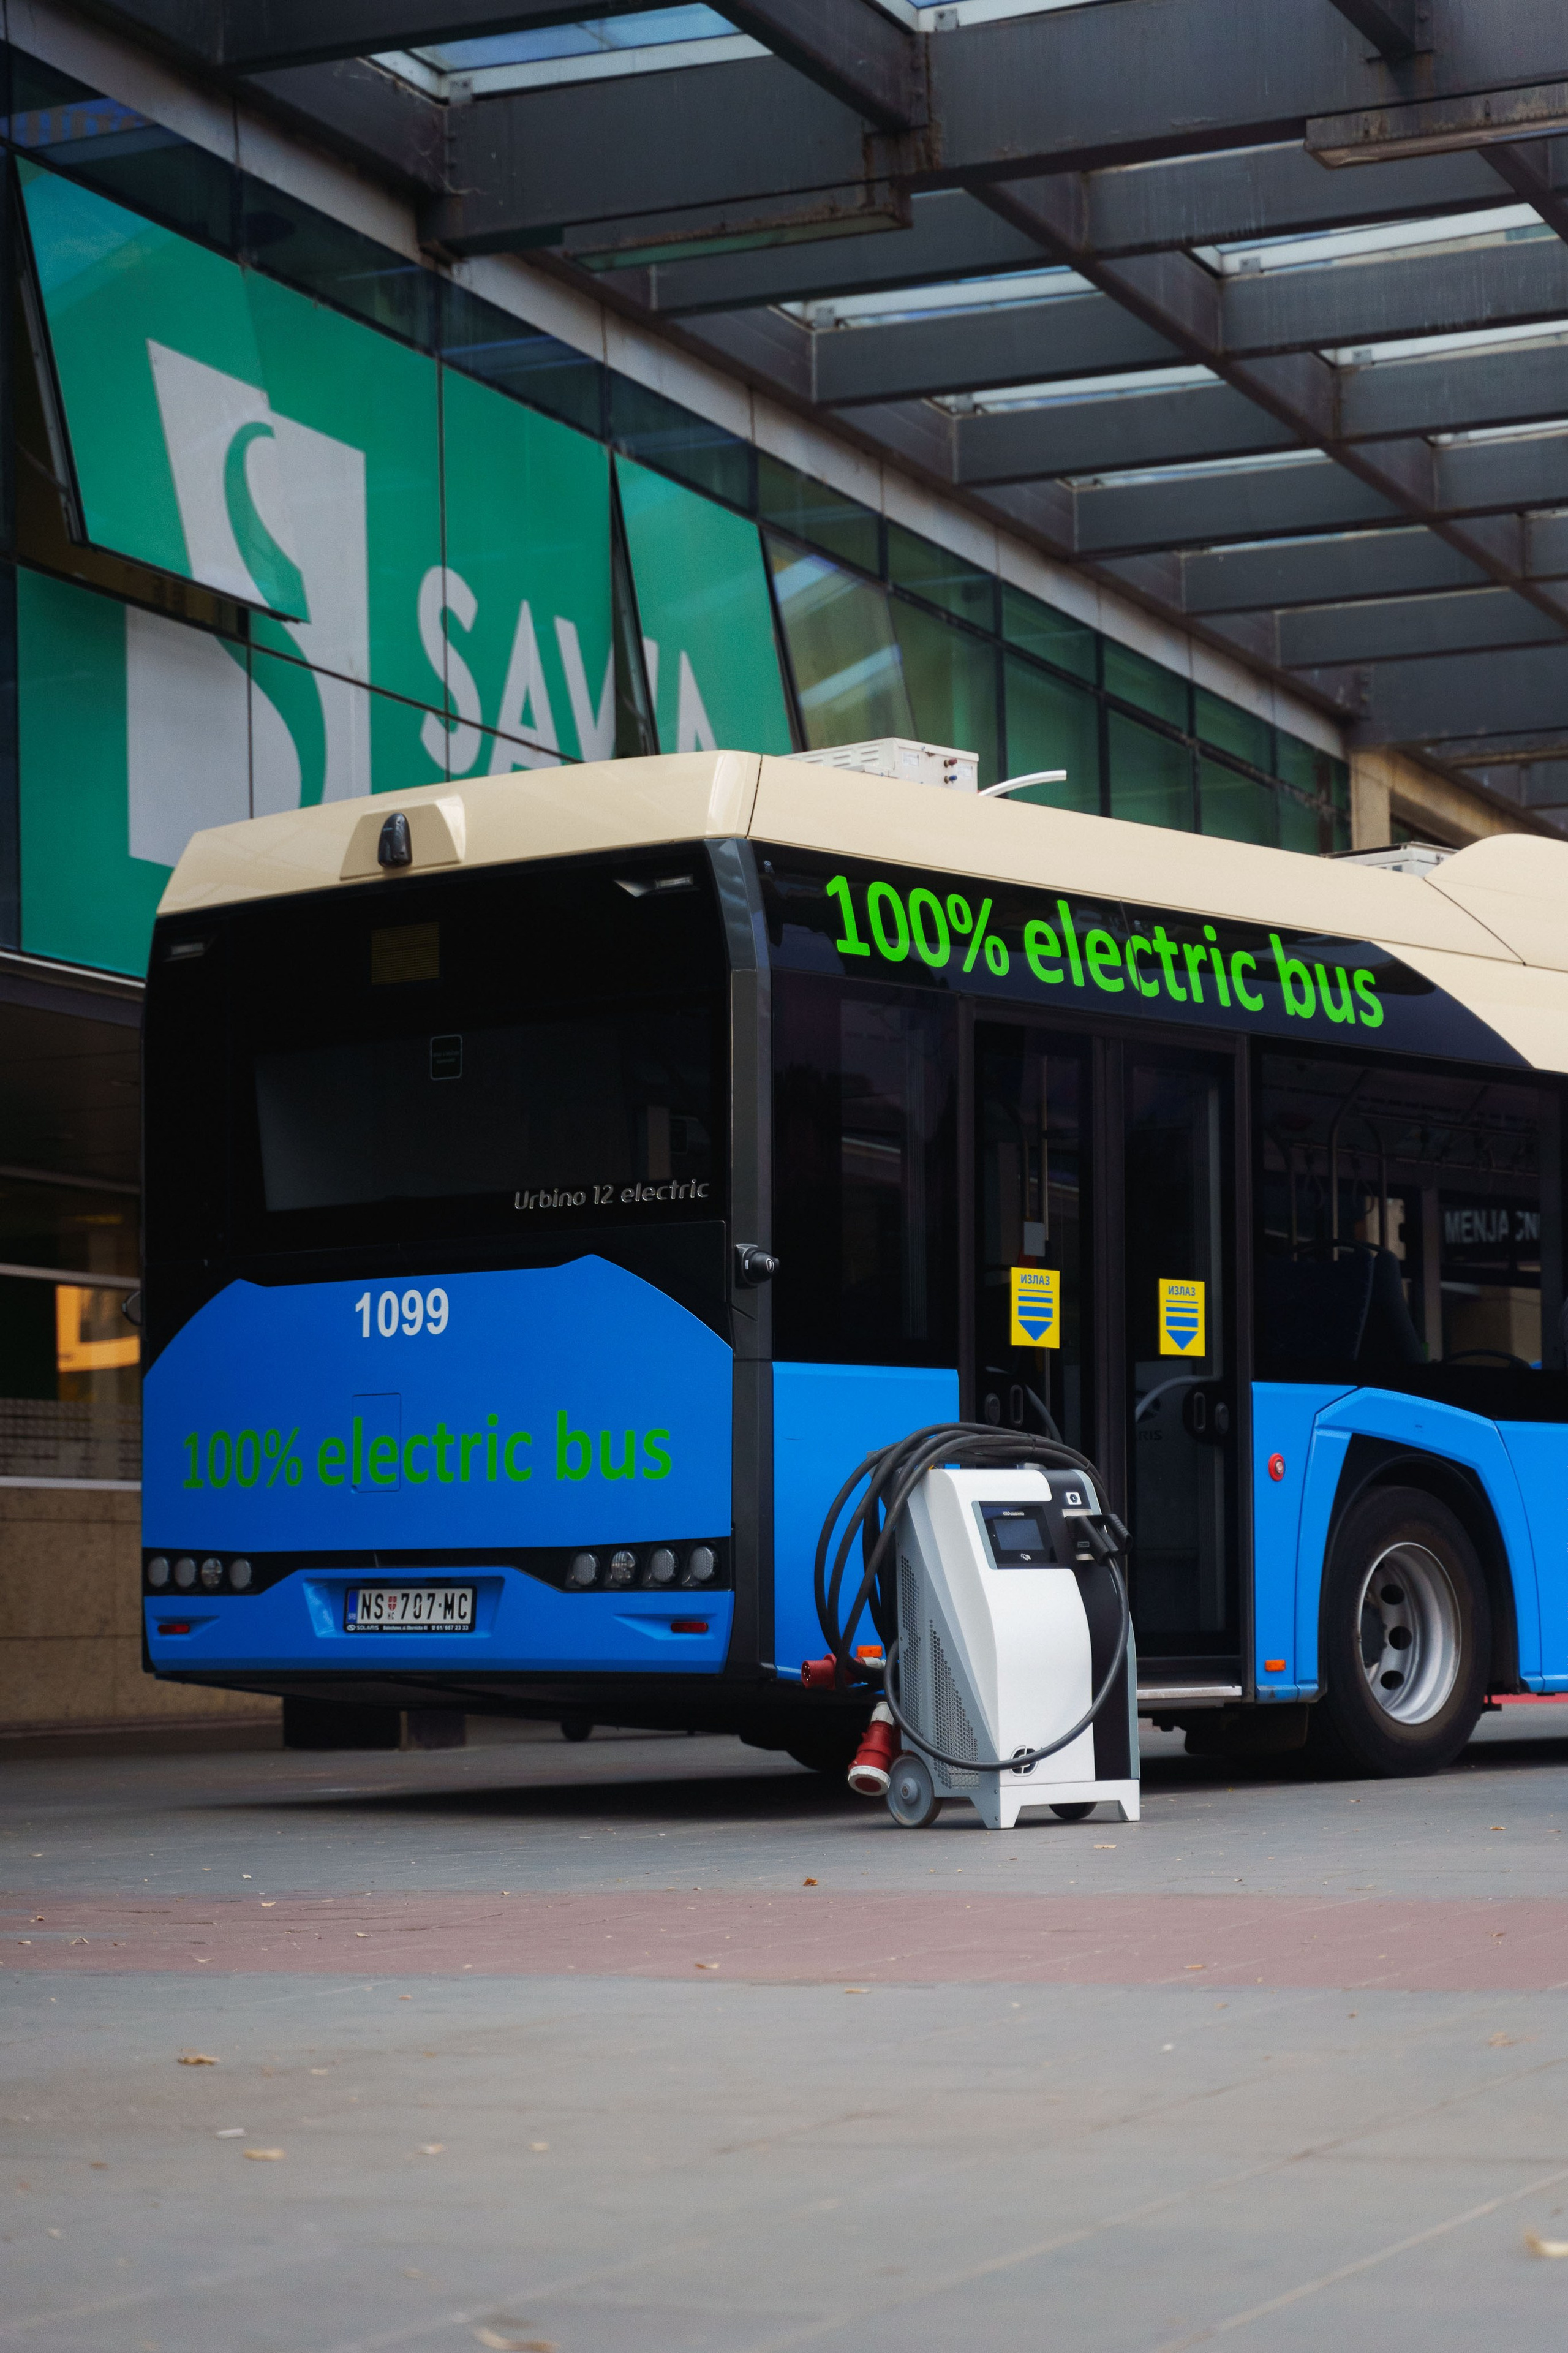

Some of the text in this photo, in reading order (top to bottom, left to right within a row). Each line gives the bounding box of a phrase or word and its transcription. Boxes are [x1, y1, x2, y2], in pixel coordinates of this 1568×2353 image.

[826, 875, 1384, 1028] 100% electric bus
[514, 1178, 710, 1210] Urbino 12 electric
[1020, 1274, 1050, 1285] ИЗЛАЗ
[1168, 1285, 1196, 1296] ИЗЛАЗ
[355, 1287, 449, 1338] 1099
[184, 1410, 672, 1489] 100% electric bus
[361, 1592, 385, 1620] NS
